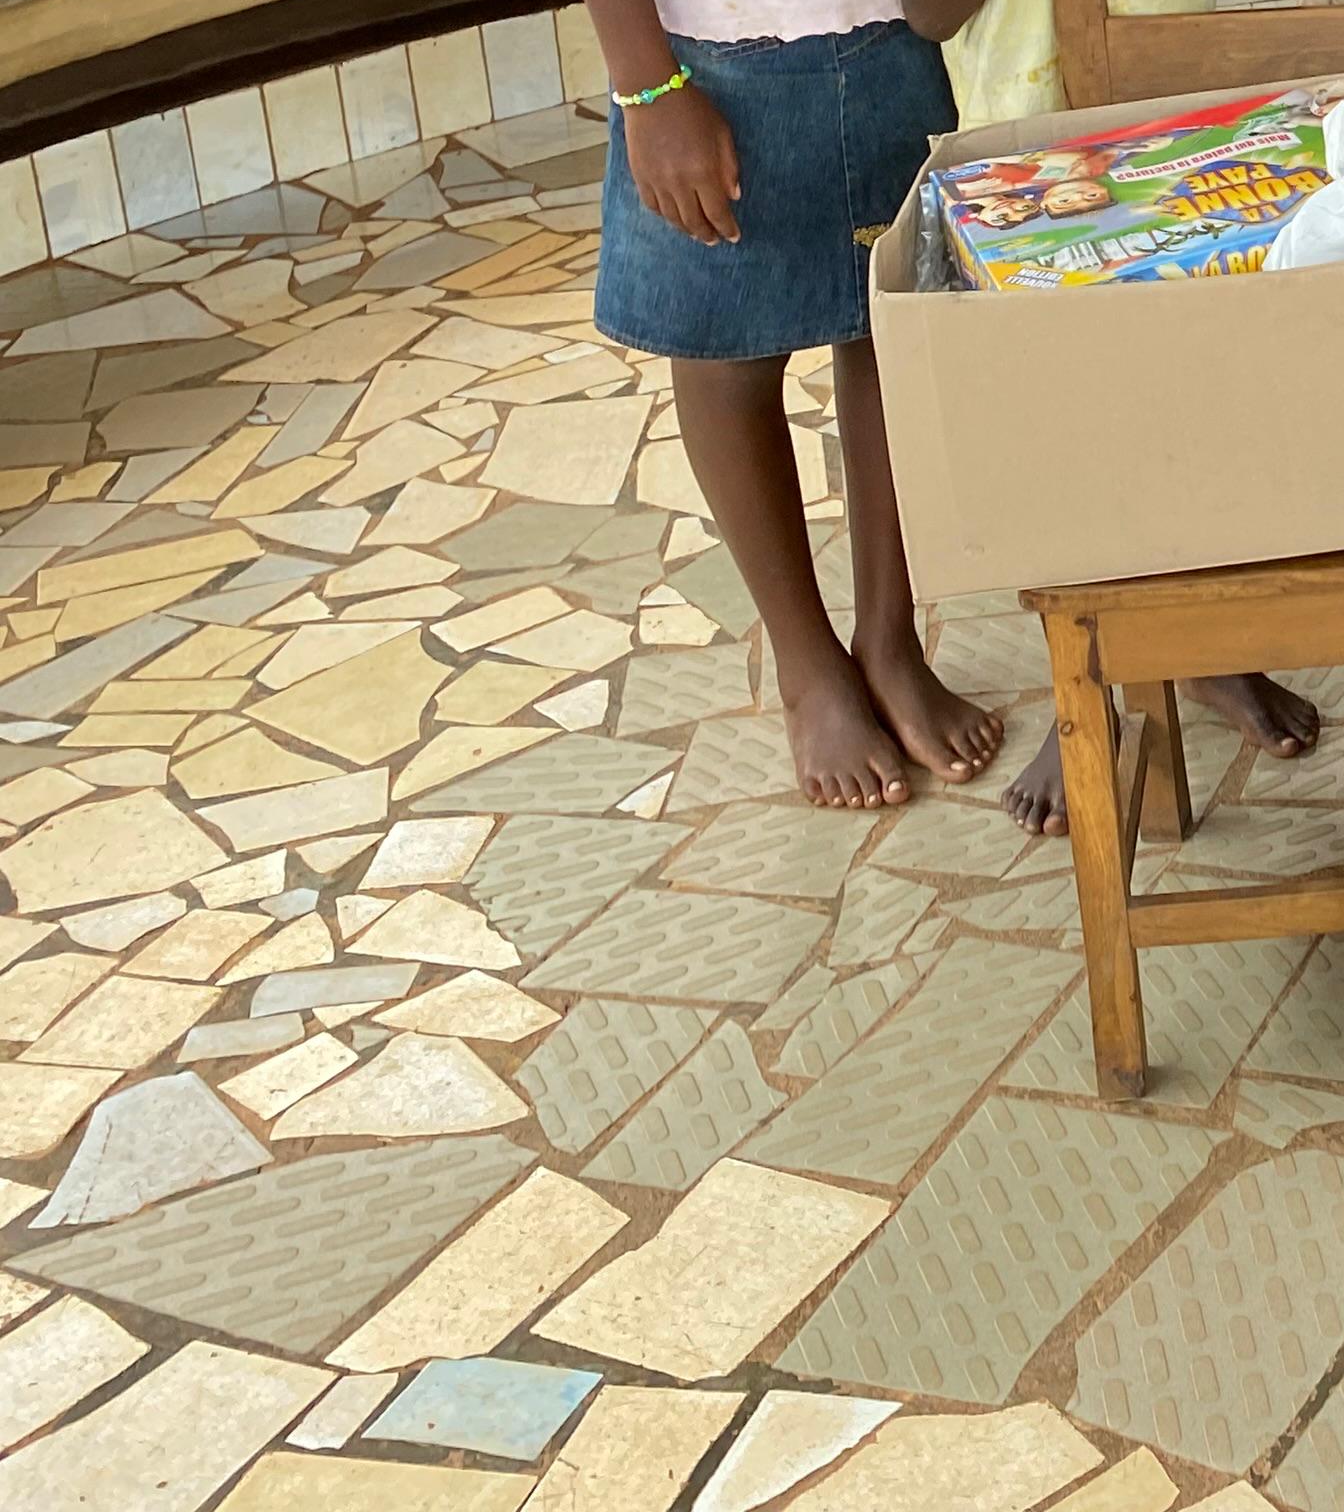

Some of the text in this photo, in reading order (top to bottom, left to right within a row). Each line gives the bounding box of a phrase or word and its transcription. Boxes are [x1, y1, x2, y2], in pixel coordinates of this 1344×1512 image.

[1183, 163, 1273, 194] PAYE
[1163, 169, 1328, 222] BONNE
[1239, 203, 1282, 223] LA
